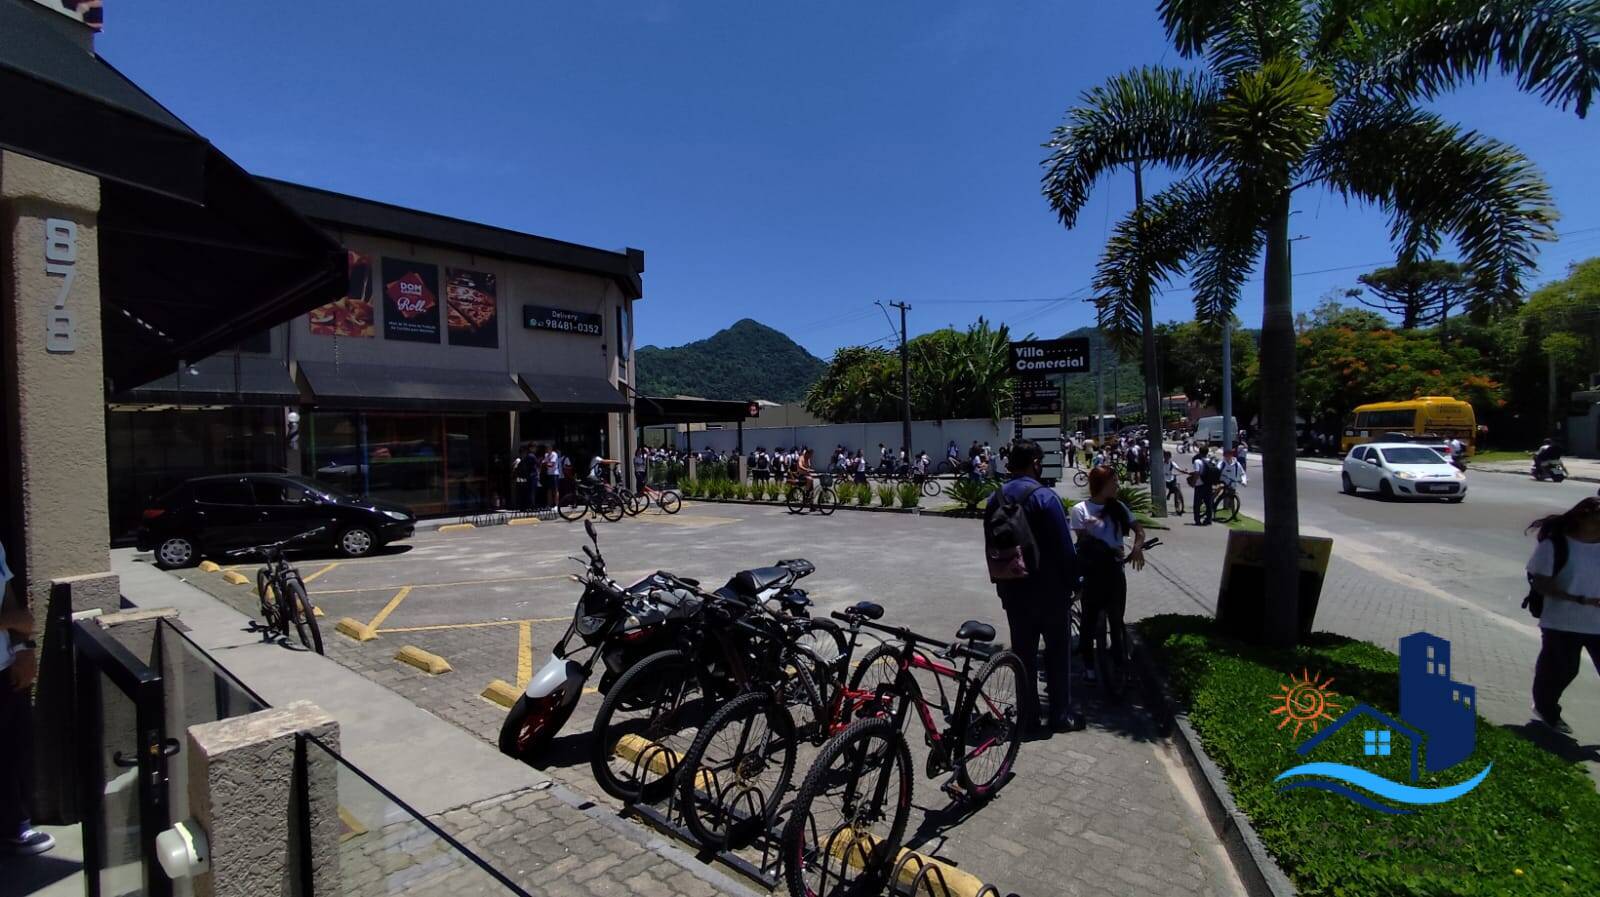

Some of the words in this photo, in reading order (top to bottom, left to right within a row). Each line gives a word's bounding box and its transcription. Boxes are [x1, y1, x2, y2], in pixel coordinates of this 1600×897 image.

[46, 218, 77, 353] 878
[400, 282, 422, 293] DOM
[551, 310, 578, 321] Delivery
[545, 319, 600, 334] 98481-0352
[1016, 347, 1044, 357] Villa
[1016, 356, 1084, 370] Comercial
